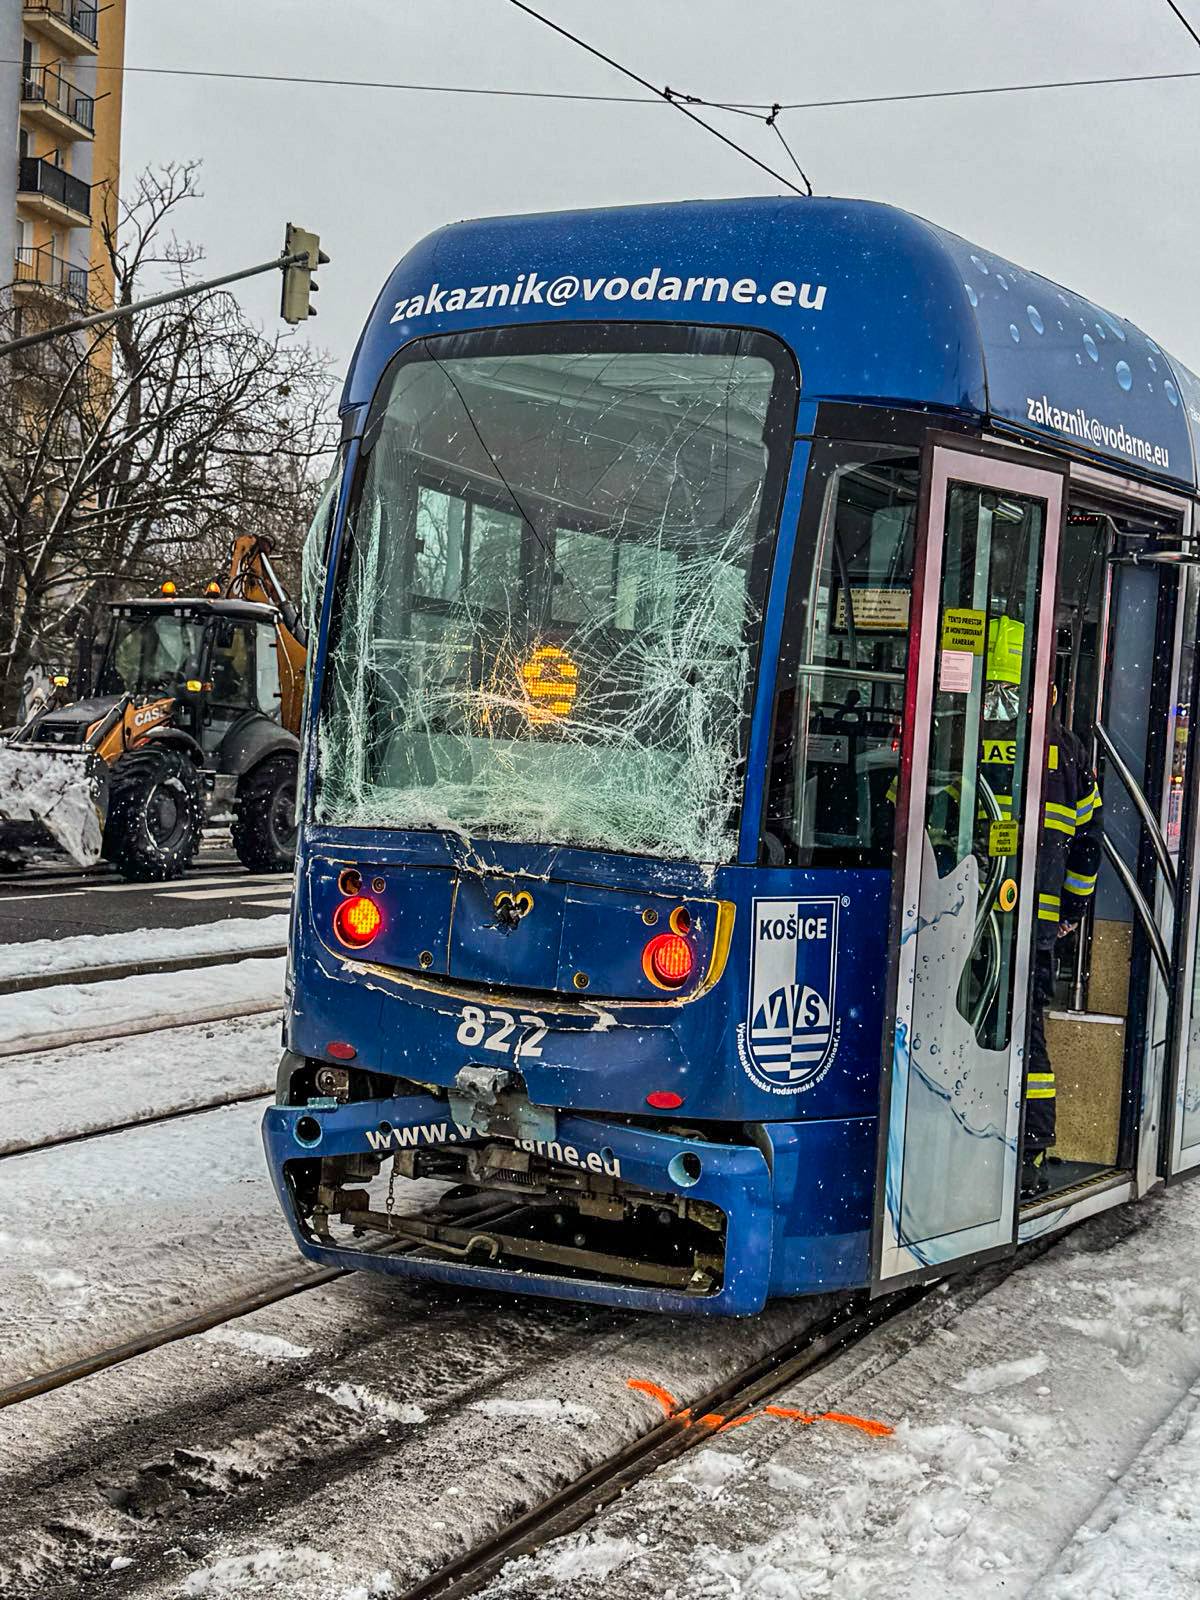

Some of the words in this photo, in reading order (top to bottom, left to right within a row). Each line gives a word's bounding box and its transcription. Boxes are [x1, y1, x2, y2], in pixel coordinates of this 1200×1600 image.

[390, 267, 828, 325] zakaznik@vodarne.eu
[1026, 395, 1170, 468] zakaznik@vodarne.eu
[759, 914, 828, 941] KOŠICE
[456, 1005, 548, 1057] 822
